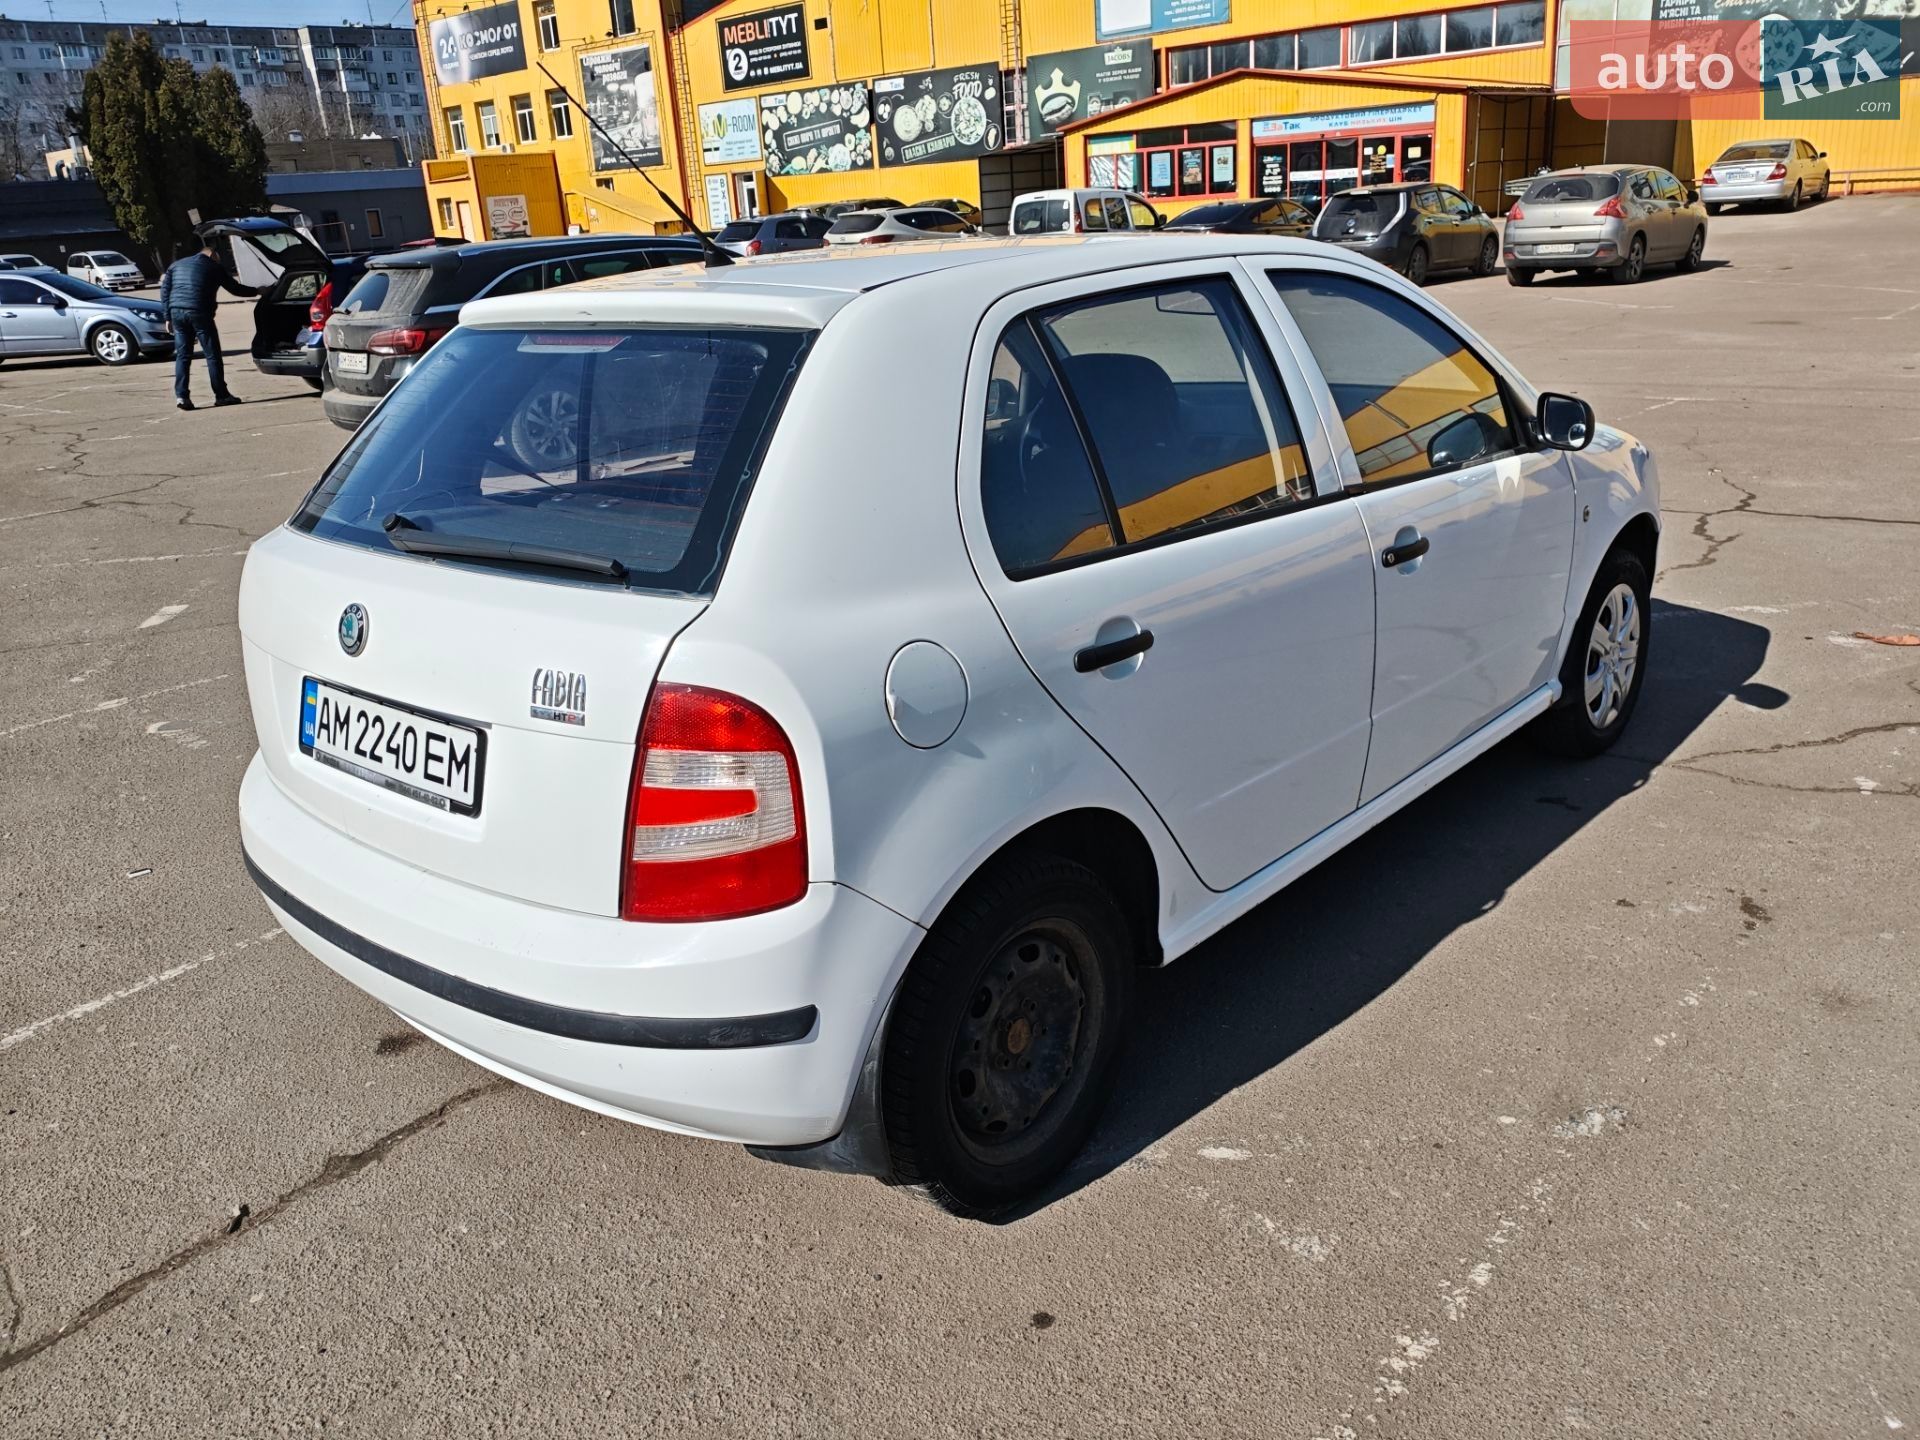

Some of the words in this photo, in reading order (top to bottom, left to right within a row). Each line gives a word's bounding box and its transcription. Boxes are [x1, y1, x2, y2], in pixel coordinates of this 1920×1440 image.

[1690, 5, 1701, 15] ТА
[733, 53, 743, 71] 2
[953, 71, 980, 83] FRESH
[952, 80, 983, 100] FOOD
[1328, 120, 1349, 128] КЛУБ
[531, 668, 586, 712] FABIA
[553, 711, 577, 722] HTP
[304, 722, 315, 737] UA
[316, 696, 351, 751] AM
[353, 709, 418, 774] 2240
[423, 730, 471, 793] EM
